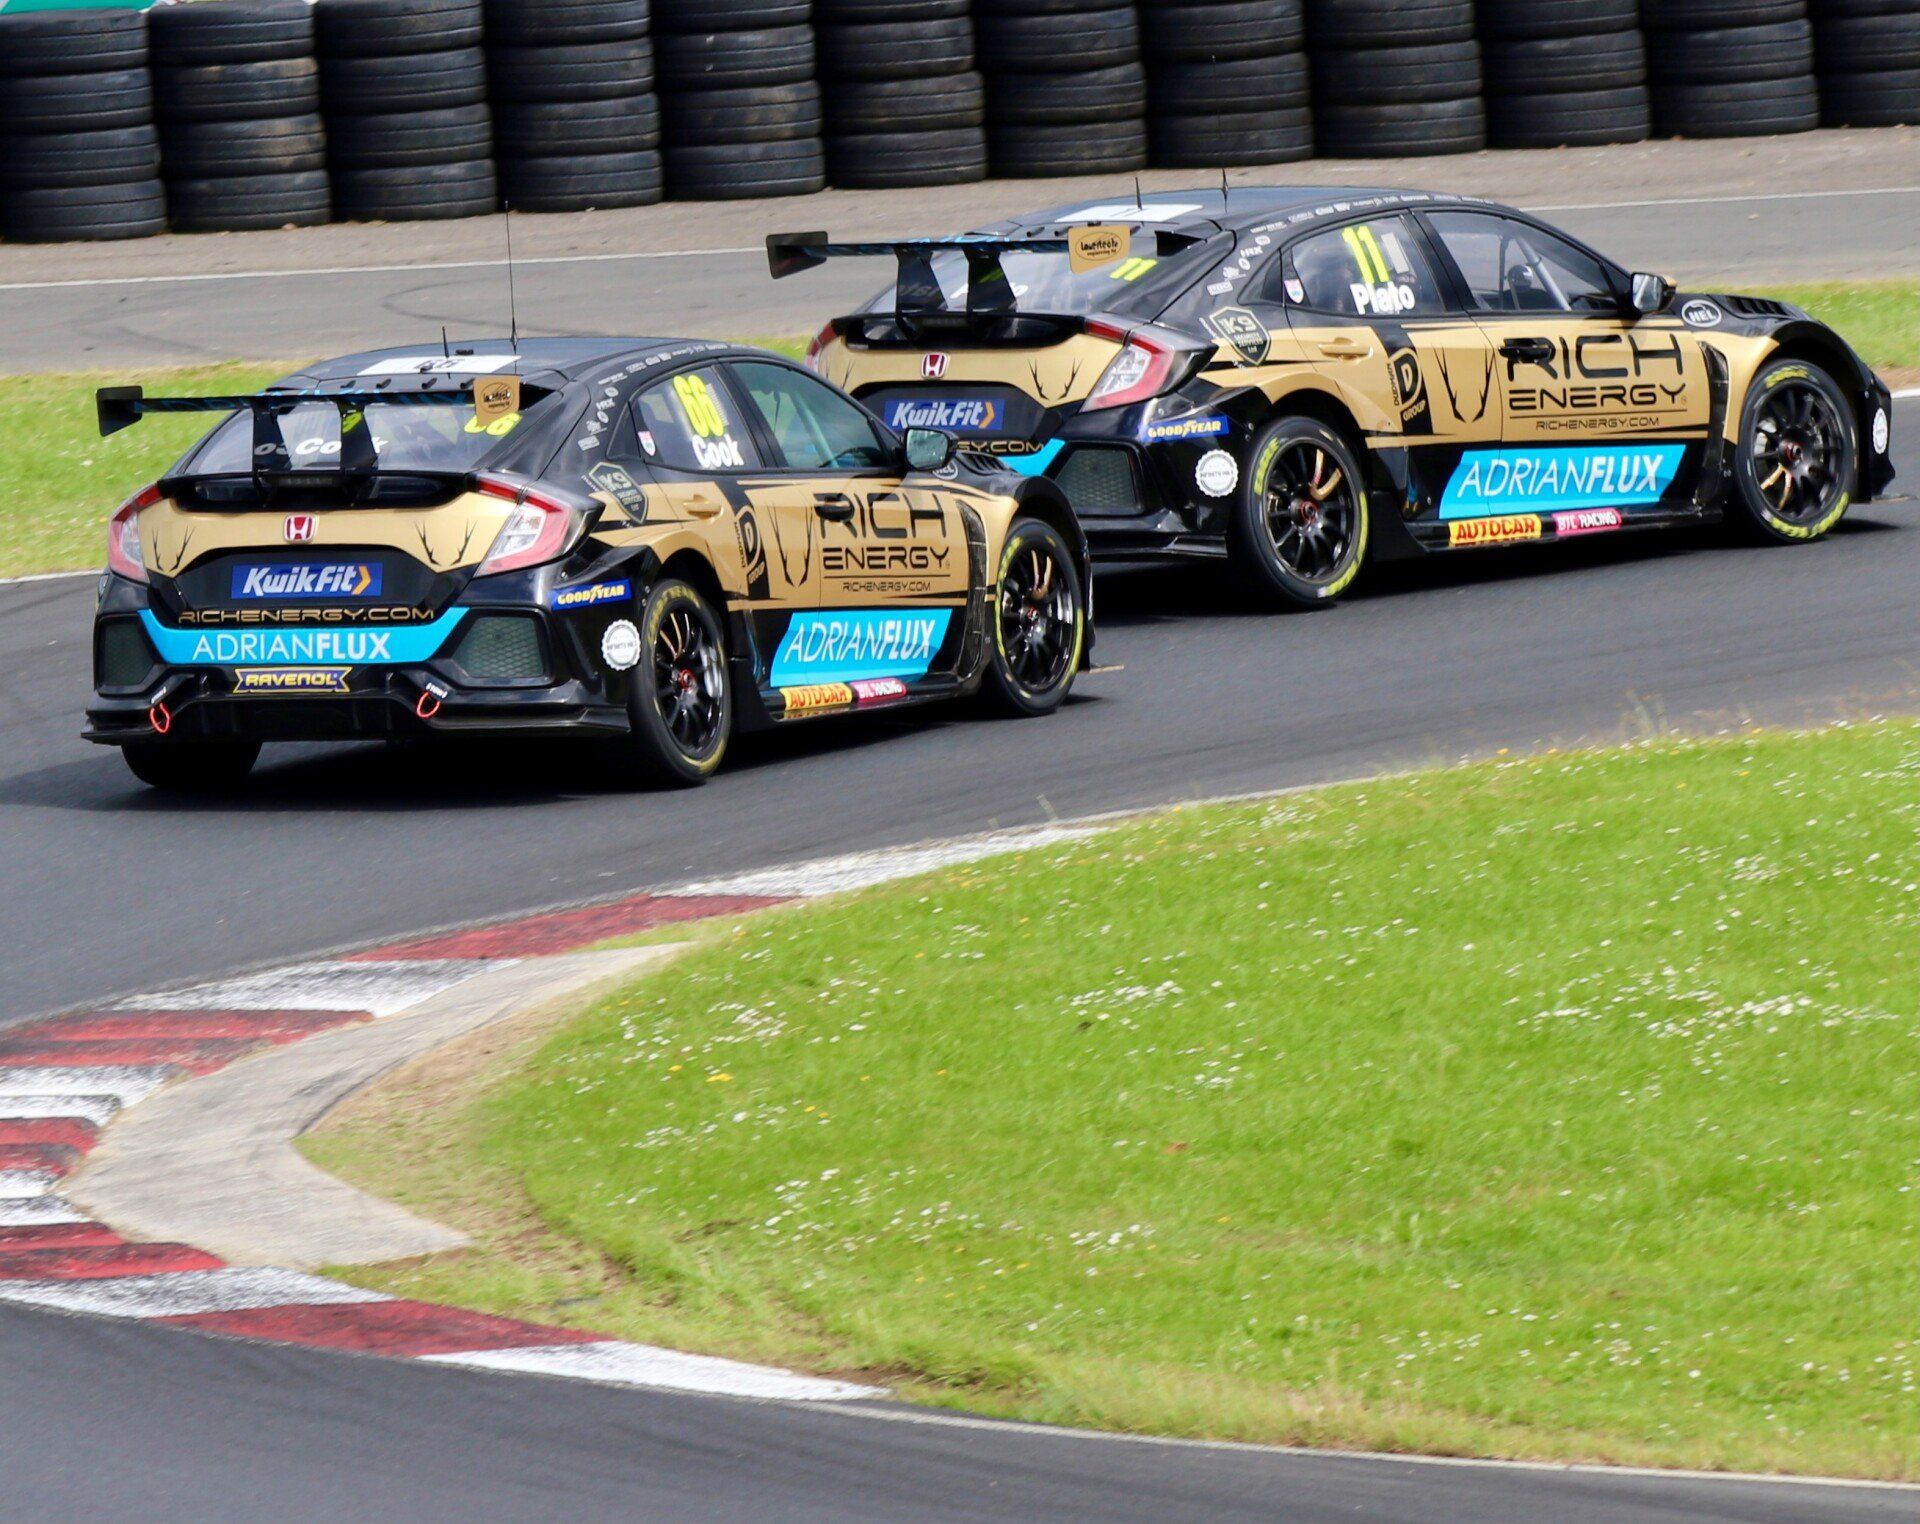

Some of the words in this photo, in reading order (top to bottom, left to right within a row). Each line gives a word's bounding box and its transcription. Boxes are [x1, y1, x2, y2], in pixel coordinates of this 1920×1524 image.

[1342, 225, 1390, 284] 11
[1109, 257, 1157, 281] 11
[1350, 281, 1415, 315] Plato
[1218, 316, 1256, 334] K9
[1689, 309, 1716, 321] HEL
[1504, 333, 1683, 382] RICH
[674, 375, 726, 437] 66
[1509, 383, 1686, 410] ENERGY
[1403, 399, 1426, 421] GROUP
[1148, 420, 1221, 438] GOODYEAR
[1536, 417, 1659, 431] RICHENERGY.COM
[692, 433, 744, 468] Cook
[1458, 453, 1664, 498] ADRIANFLUX
[813, 492, 948, 539] RICH
[1557, 514, 1578, 532] BTC
[1578, 511, 1617, 529] RACING
[1456, 517, 1535, 540] AUTOCAR
[822, 546, 950, 570] ENERGY
[557, 584, 626, 605] GOODYEAR
[843, 581, 931, 592] RICHENERGY.COM
[178, 606, 435, 625] RICHENERGY.COM
[192, 632, 391, 661] ADRIANFLUX
[784, 618, 936, 664] ADRIANFLUX
[245, 672, 337, 687] RAVENOL
